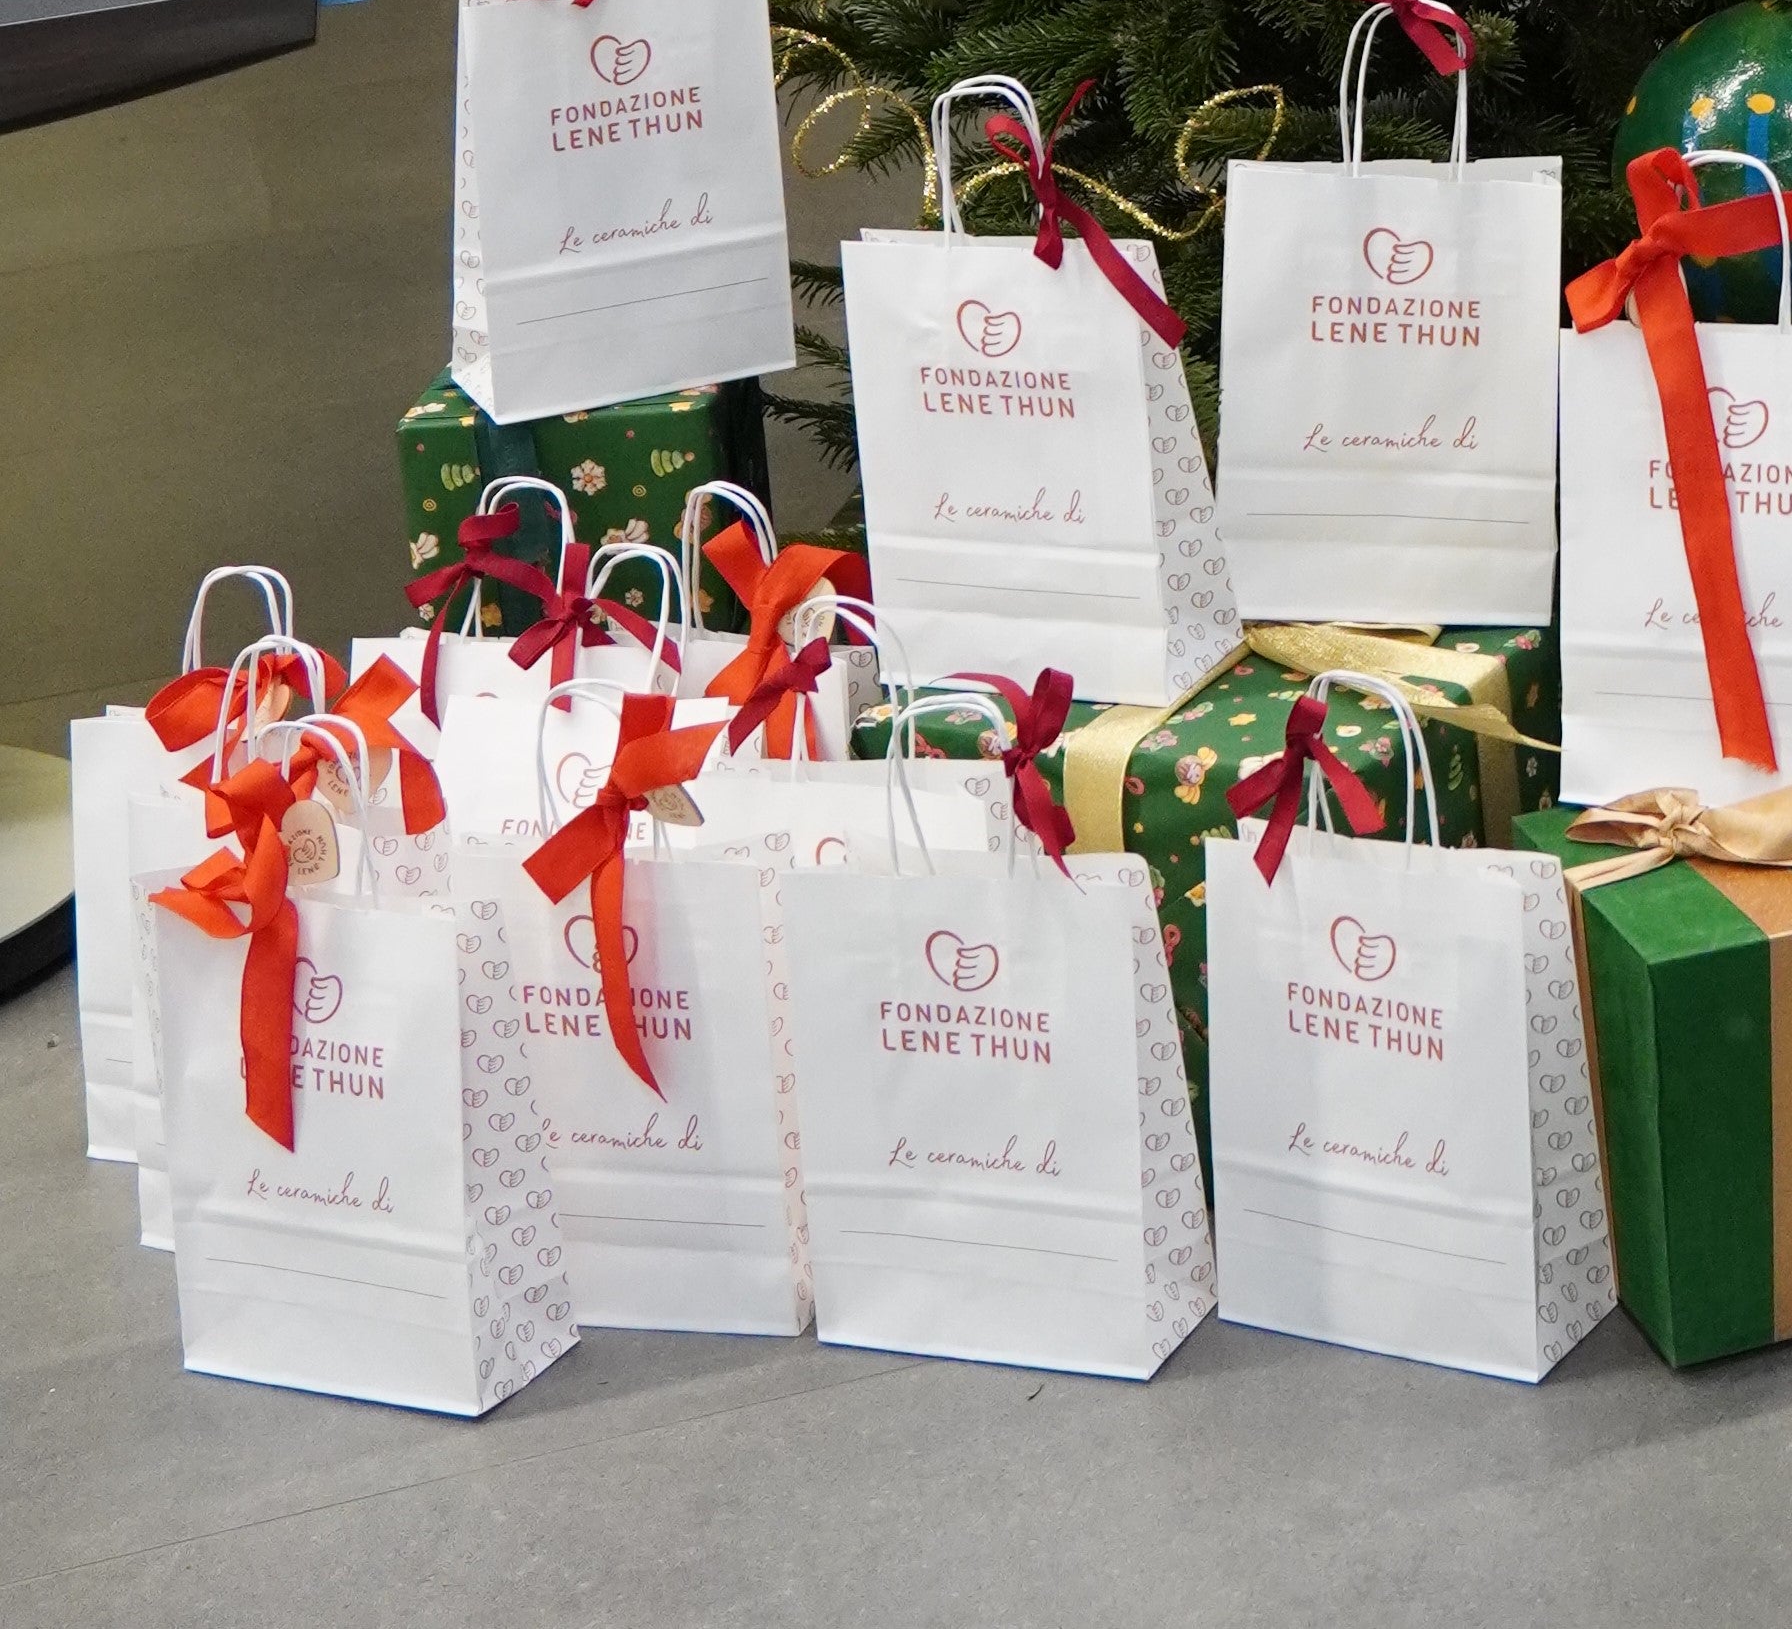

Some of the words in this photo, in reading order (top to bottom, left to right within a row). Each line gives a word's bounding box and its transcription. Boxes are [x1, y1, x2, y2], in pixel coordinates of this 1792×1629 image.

[550, 86, 701, 127] FONDAZIONE
[552, 122, 621, 153] LENE
[627, 109, 703, 139] THUN
[559, 226, 584, 255] Le
[592, 198, 682, 244] ceramiche
[690, 192, 713, 226] di
[1312, 295, 1481, 319] FONDAZIONE
[1311, 320, 1388, 344] LENE
[1397, 323, 1480, 347] THUN
[919, 366, 1071, 391] FONDAZIONE
[923, 391, 993, 415] LENE
[999, 394, 1075, 419] THUN
[1303, 423, 1333, 453] Le
[1341, 414, 1442, 450] ceramiche
[1452, 415, 1479, 450] di
[934, 492, 958, 523] Le
[966, 487, 1054, 522] ceramiche
[1063, 489, 1085, 524] di
[1644, 598, 1673, 630] Le
[525, 1012, 602, 1037] LENE
[880, 1001, 1050, 1034] FONDAZIONE
[1287, 981, 1443, 1030] FONDAZIONE
[882, 1028, 961, 1055] LENE
[970, 1033, 1051, 1065] THUN
[1288, 1009, 1360, 1045] LENE
[1368, 1023, 1444, 1062] THUN
[312, 1067, 384, 1100] THUN
[571, 1112, 668, 1150] ceramiche
[677, 1114, 703, 1151] di
[1288, 1122, 1315, 1157] Le
[1323, 1131, 1416, 1169] ceramiche
[1425, 1138, 1449, 1177] di
[888, 1136, 918, 1169] Le
[927, 1134, 1026, 1172] ceramiche
[1036, 1140, 1061, 1177] di
[247, 1168, 269, 1200] Le
[277, 1171, 363, 1208] ceramiche
[371, 1176, 394, 1214] di
